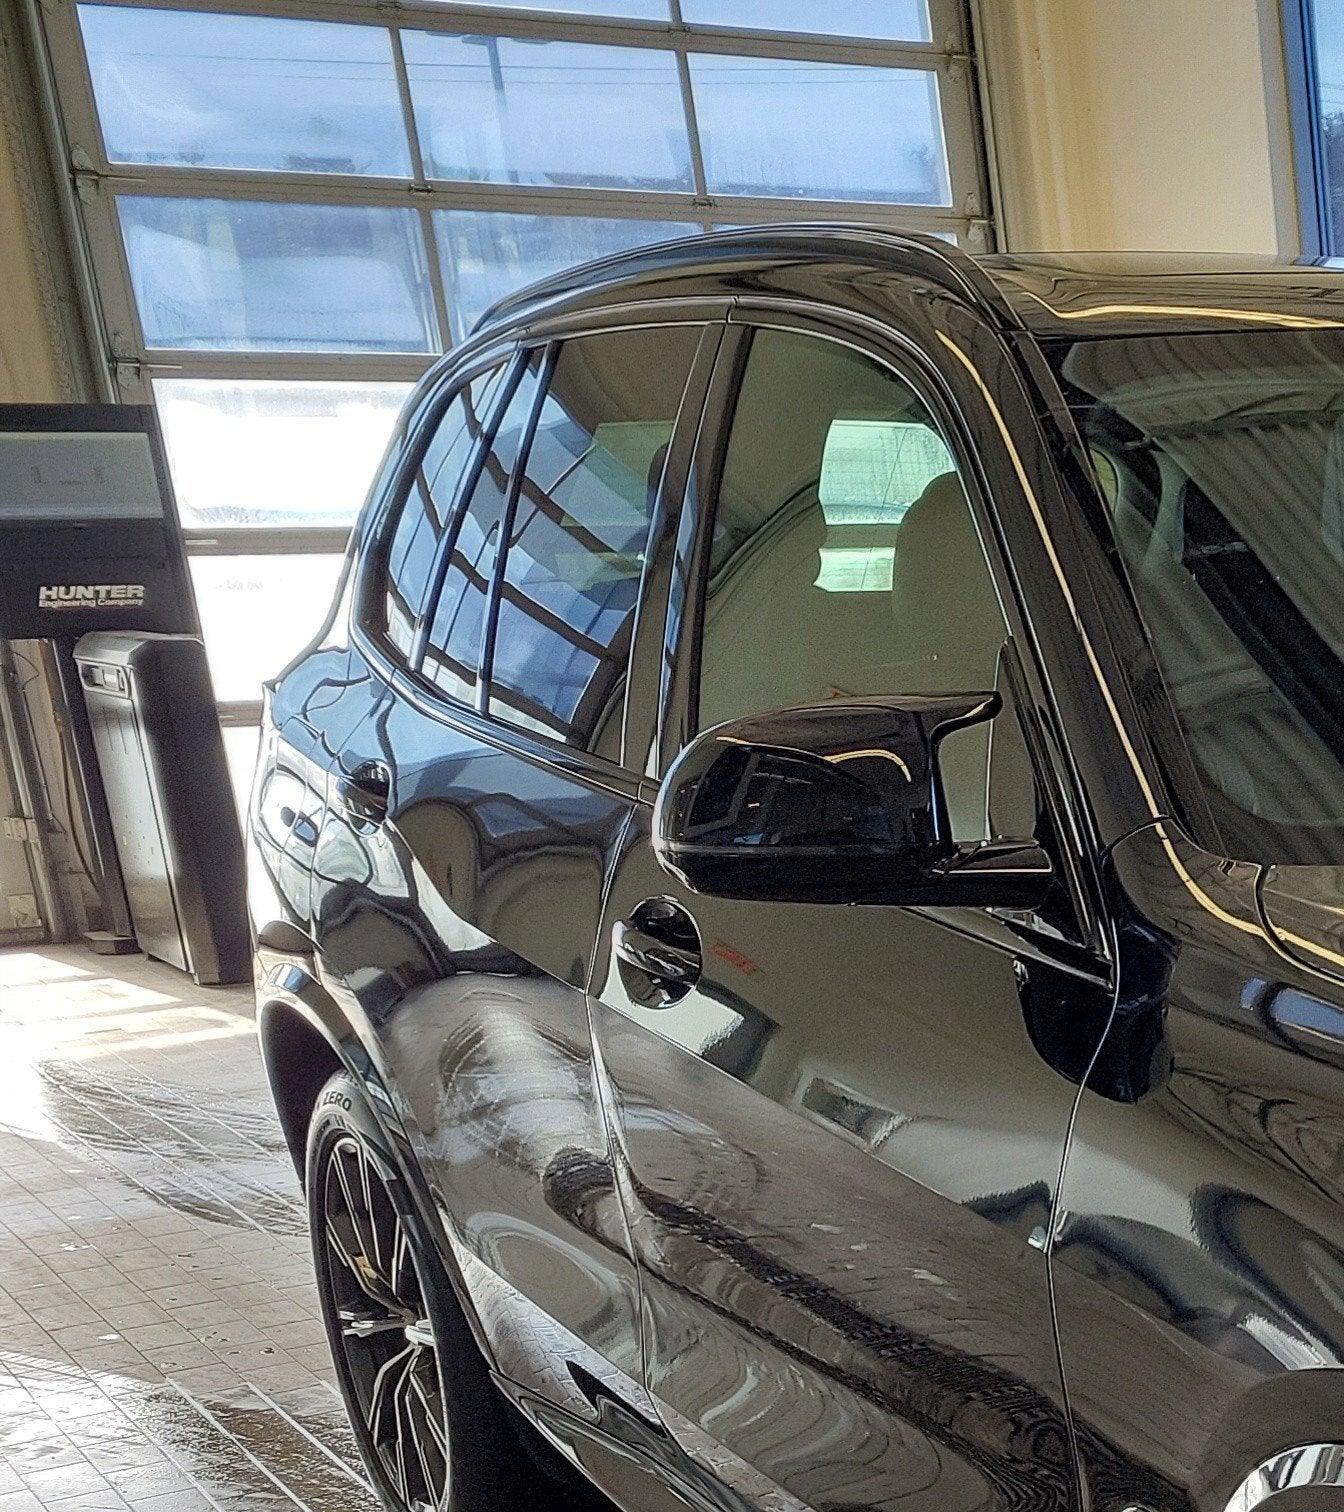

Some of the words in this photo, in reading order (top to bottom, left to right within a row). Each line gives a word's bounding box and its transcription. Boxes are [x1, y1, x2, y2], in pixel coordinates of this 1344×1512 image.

[39, 585, 145, 600] HUNTER
[38, 599, 96, 609] Engineering
[97, 598, 144, 607] Company
[323, 1091, 352, 1112] ZERO
